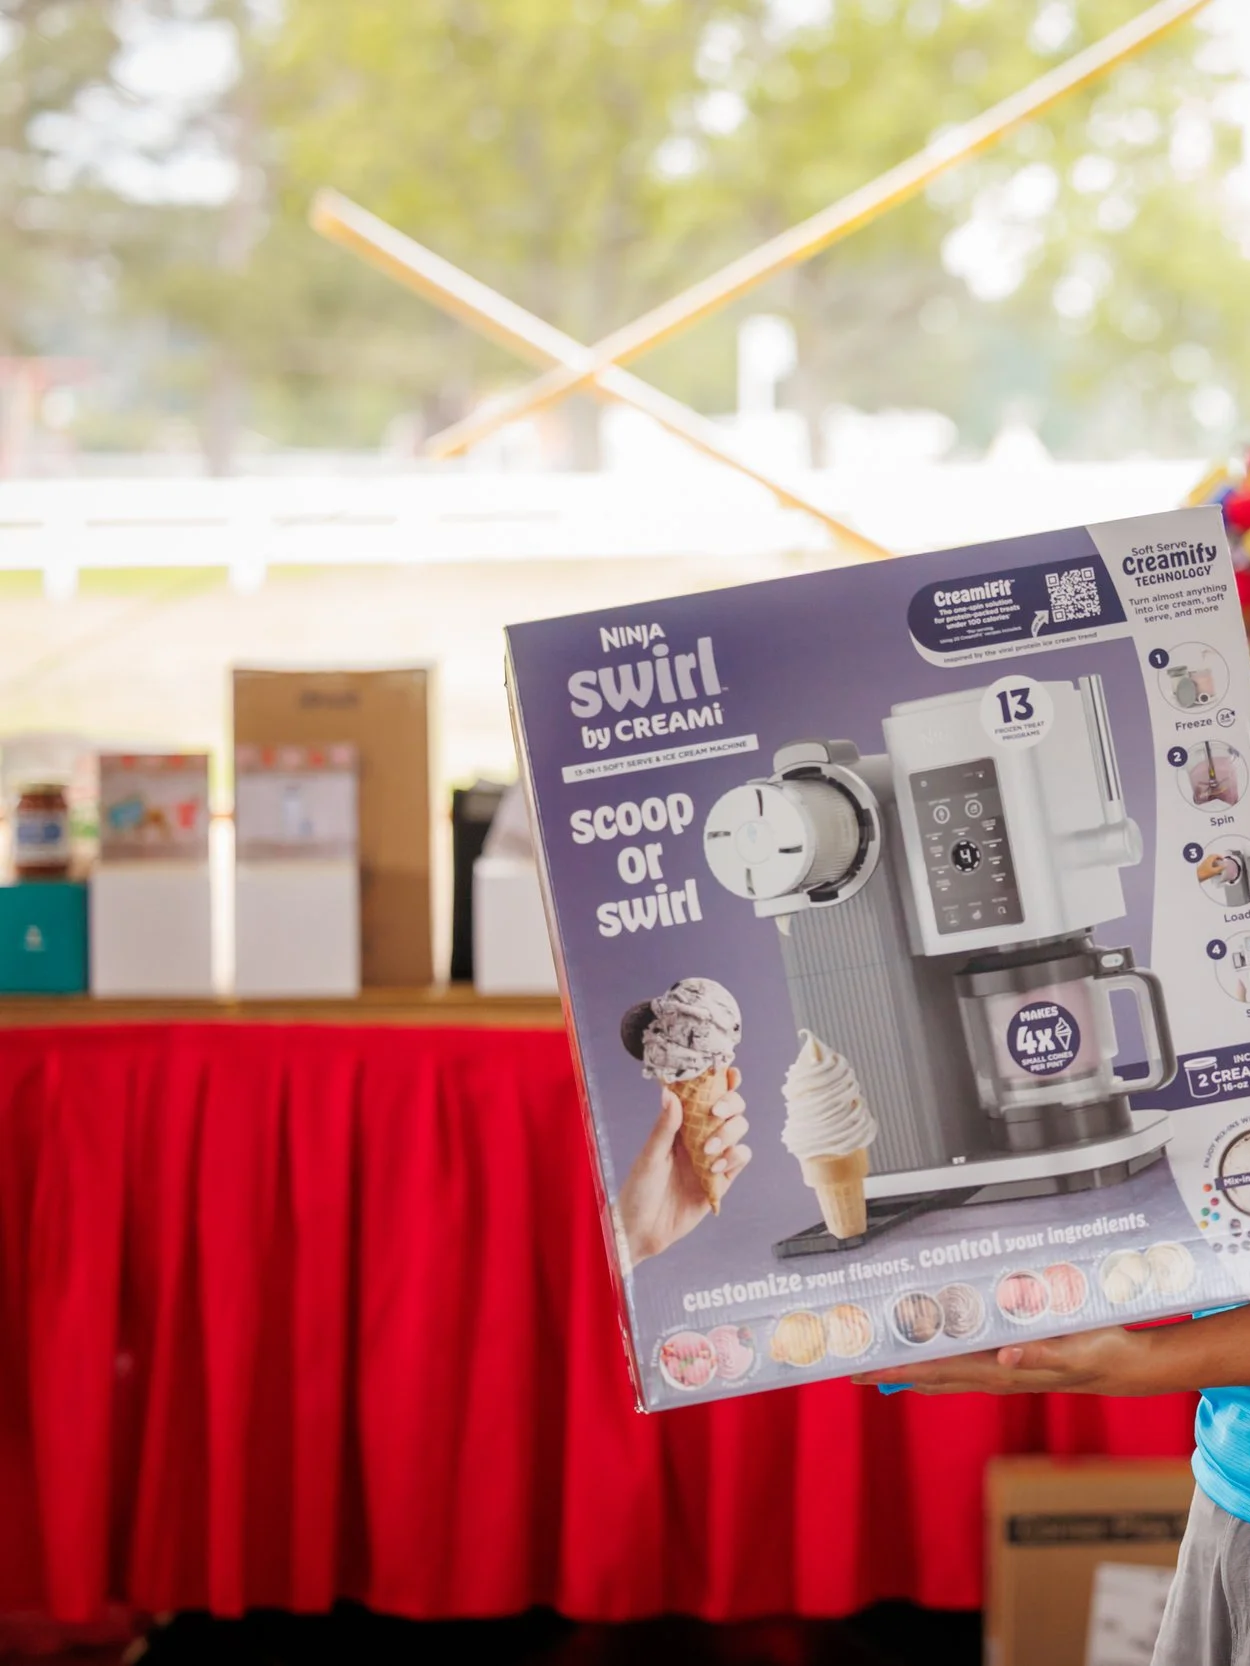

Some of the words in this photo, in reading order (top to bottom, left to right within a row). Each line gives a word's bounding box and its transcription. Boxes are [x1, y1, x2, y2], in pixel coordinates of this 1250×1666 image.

[1131, 545, 1154, 556] Soft
[1157, 541, 1187, 552] Serve
[1122, 543, 1217, 575] Creamify
[1135, 565, 1211, 587] TECHNOLOGY
[934, 579, 1012, 607] CreamiFit
[1129, 597, 1150, 606] Turn
[1152, 591, 1183, 602] almost
[1186, 584, 1227, 596] anything
[953, 603, 984, 614] one-spin
[984, 598, 1014, 608] solution
[1135, 605, 1153, 615] into
[1156, 602, 1169, 611] ice
[1172, 598, 1204, 608] cream,
[1206, 593, 1224, 603] soft
[1144, 613, 1172, 623] serve,
[1174, 608, 1192, 618] and
[1194, 604, 1219, 615] more
[946, 608, 999, 623] protein-packed
[999, 605, 1020, 613] treats
[946, 621, 967, 630] under
[968, 618, 981, 626] 100
[600, 623, 665, 652] NINJA
[974, 652, 983, 660] by
[998, 646, 1014, 654] viral
[1015, 642, 1042, 652] protein
[1043, 639, 1053, 647] ice
[1055, 636, 1076, 645] cream
[1078, 632, 1098, 641] trend
[1155, 653, 1162, 665] 1
[568, 636, 722, 718] swirl
[996, 687, 1034, 723] 13
[581, 726, 611, 750] by
[615, 702, 723, 742] CREAMi
[1024, 720, 1044, 729] TREAT
[1175, 717, 1212, 731] Freeze
[575, 766, 602, 777] 13-IN-1
[602, 761, 624, 773] SOFT
[627, 758, 653, 769] SERVE
[663, 752, 676, 761] ICE
[679, 748, 708, 759] CREAM
[710, 741, 747, 753] MACHINE
[1173, 752, 1182, 762] 2
[570, 792, 694, 844] scoop
[1210, 814, 1235, 827] Spin
[1189, 847, 1198, 859] 3
[617, 842, 664, 884] or
[596, 878, 703, 937] swirl
[1211, 944, 1221, 955] 4
[1020, 1005, 1059, 1022] MAKES
[1021, 1056, 1047, 1066] SMALL
[1047, 1050, 1073, 1060] CONES
[1030, 1062, 1046, 1072] PER
[1046, 1060, 1064, 1068] PINT
[1197, 1074, 1209, 1087] 2
[1222, 1080, 1249, 1091] 16-oz
[1203, 1143, 1216, 1168] ENJOY
[682, 1273, 803, 1312] customize
[805, 1268, 845, 1289] your
[849, 1257, 915, 1281] flavors.
[918, 1231, 1001, 1268] control
[1004, 1232, 1044, 1253] your
[1047, 1212, 1150, 1244] ingredients.
